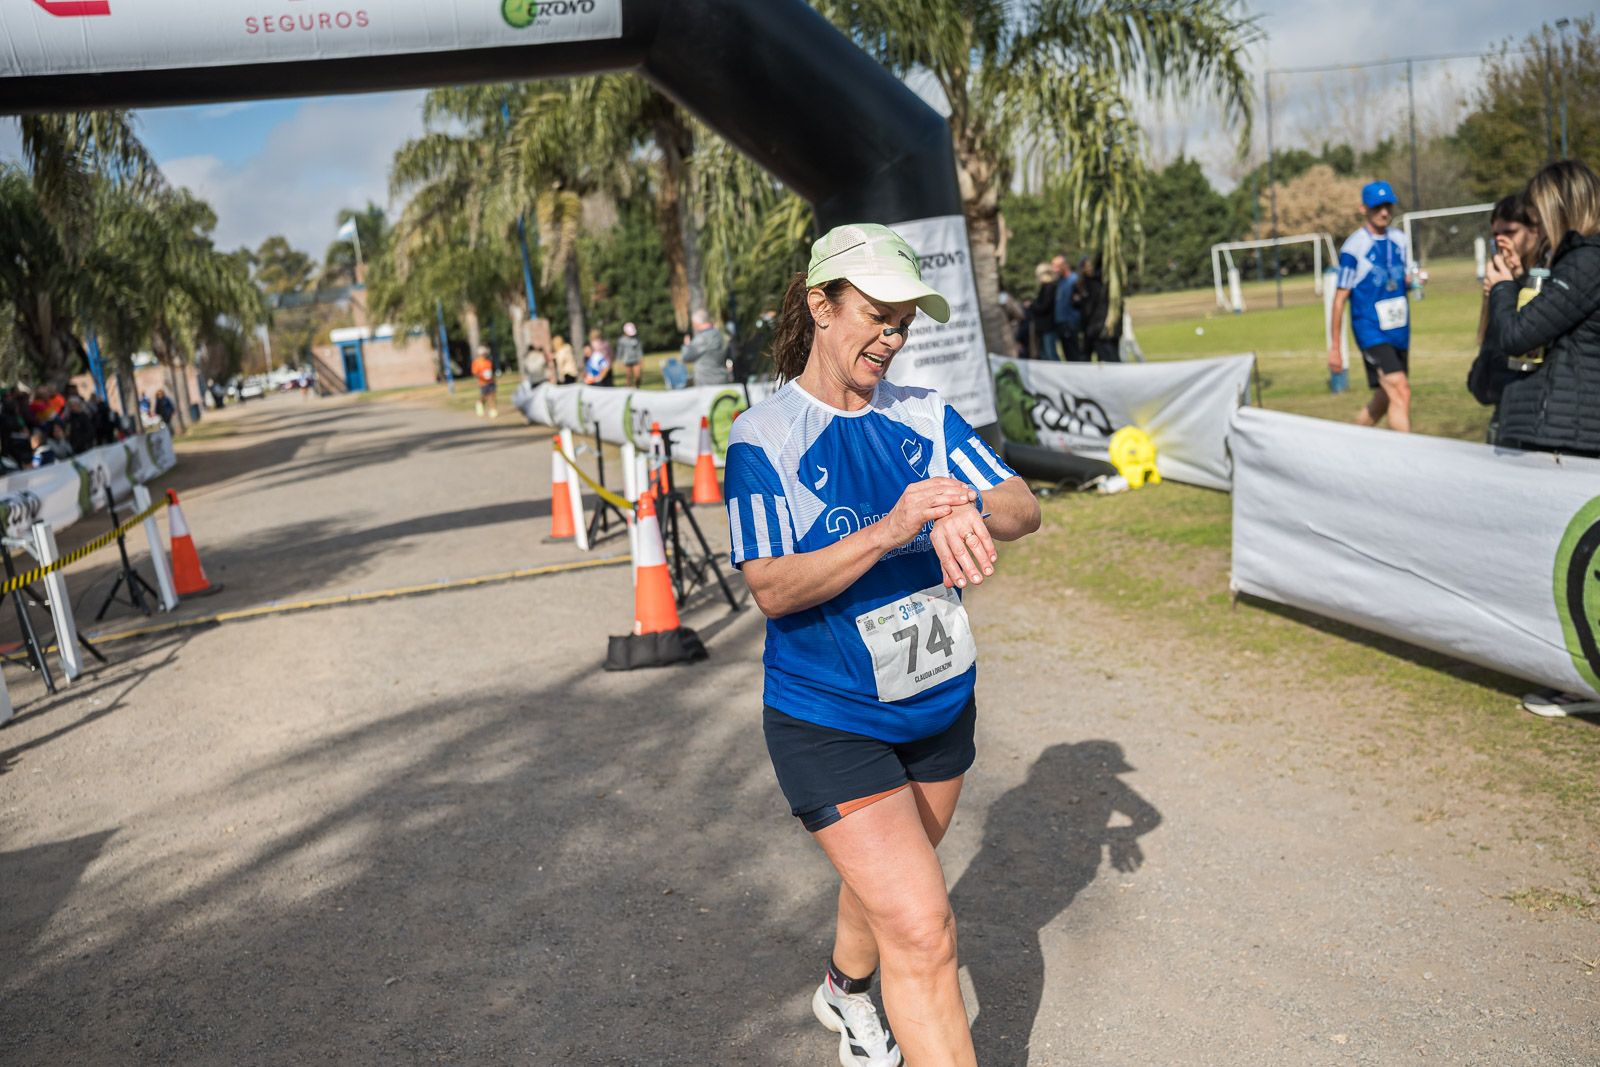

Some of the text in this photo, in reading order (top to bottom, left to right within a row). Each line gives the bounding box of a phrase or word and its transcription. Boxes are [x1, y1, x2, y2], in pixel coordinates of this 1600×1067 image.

[245, 9, 370, 34] SEGUROS
[899, 605, 910, 621] 3
[892, 614, 955, 675] 74
[914, 661, 953, 683] CLAUDIA LORENZINI
